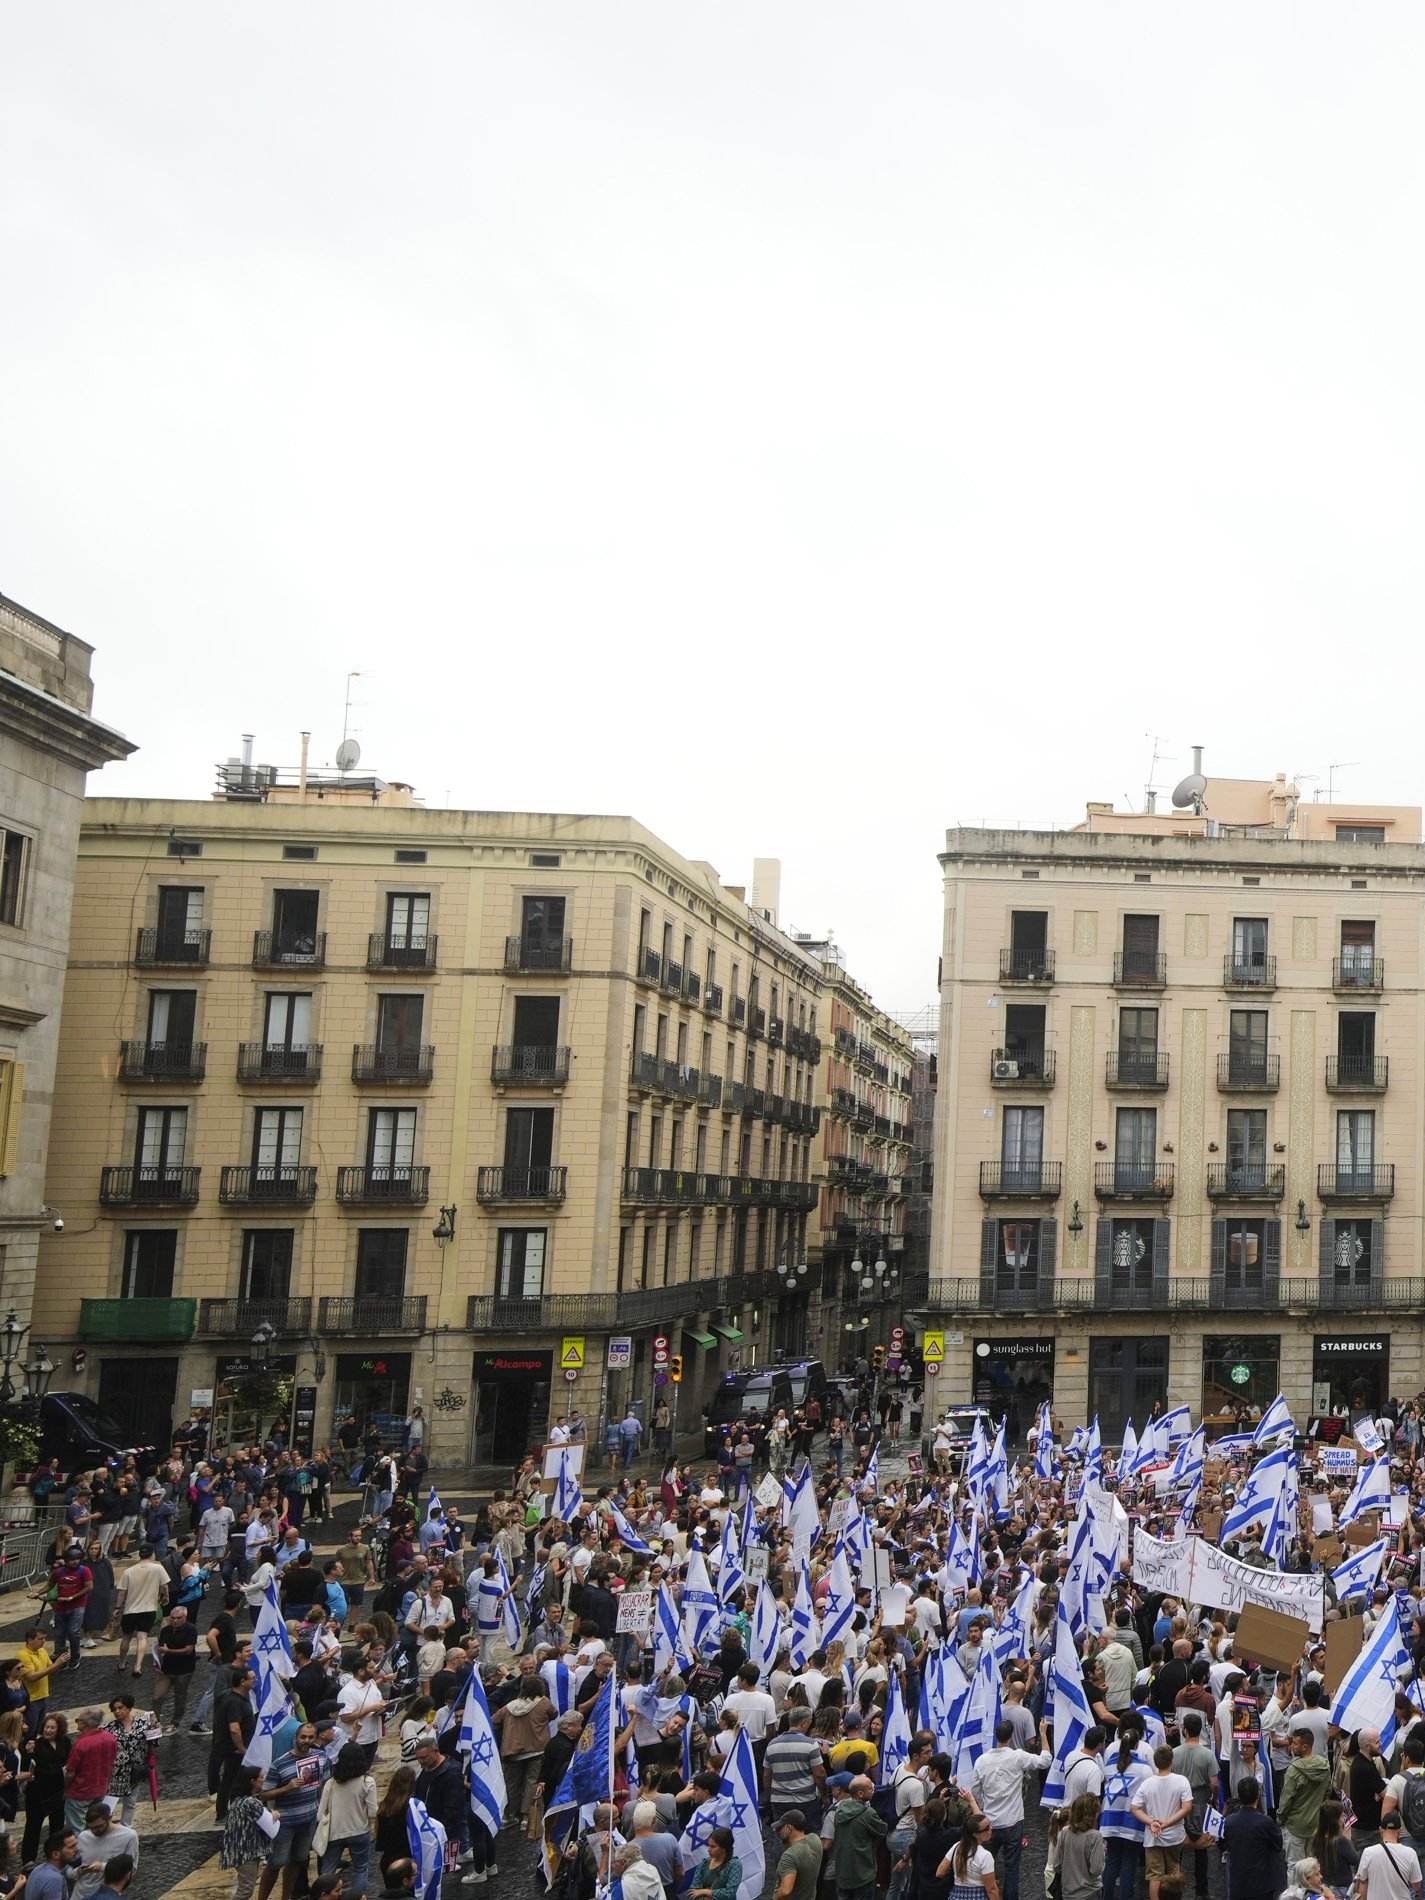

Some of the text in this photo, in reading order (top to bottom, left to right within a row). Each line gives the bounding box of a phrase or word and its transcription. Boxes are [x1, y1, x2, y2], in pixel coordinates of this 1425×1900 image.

[992, 1343, 1052, 1355] sunglass hut
[1320, 1342, 1383, 1351] STARBUCKS
[494, 1358, 542, 1370] Alcampo
[1324, 1451, 1351, 1459] SPREAD
[1327, 1459, 1356, 1467] HUMMUS
